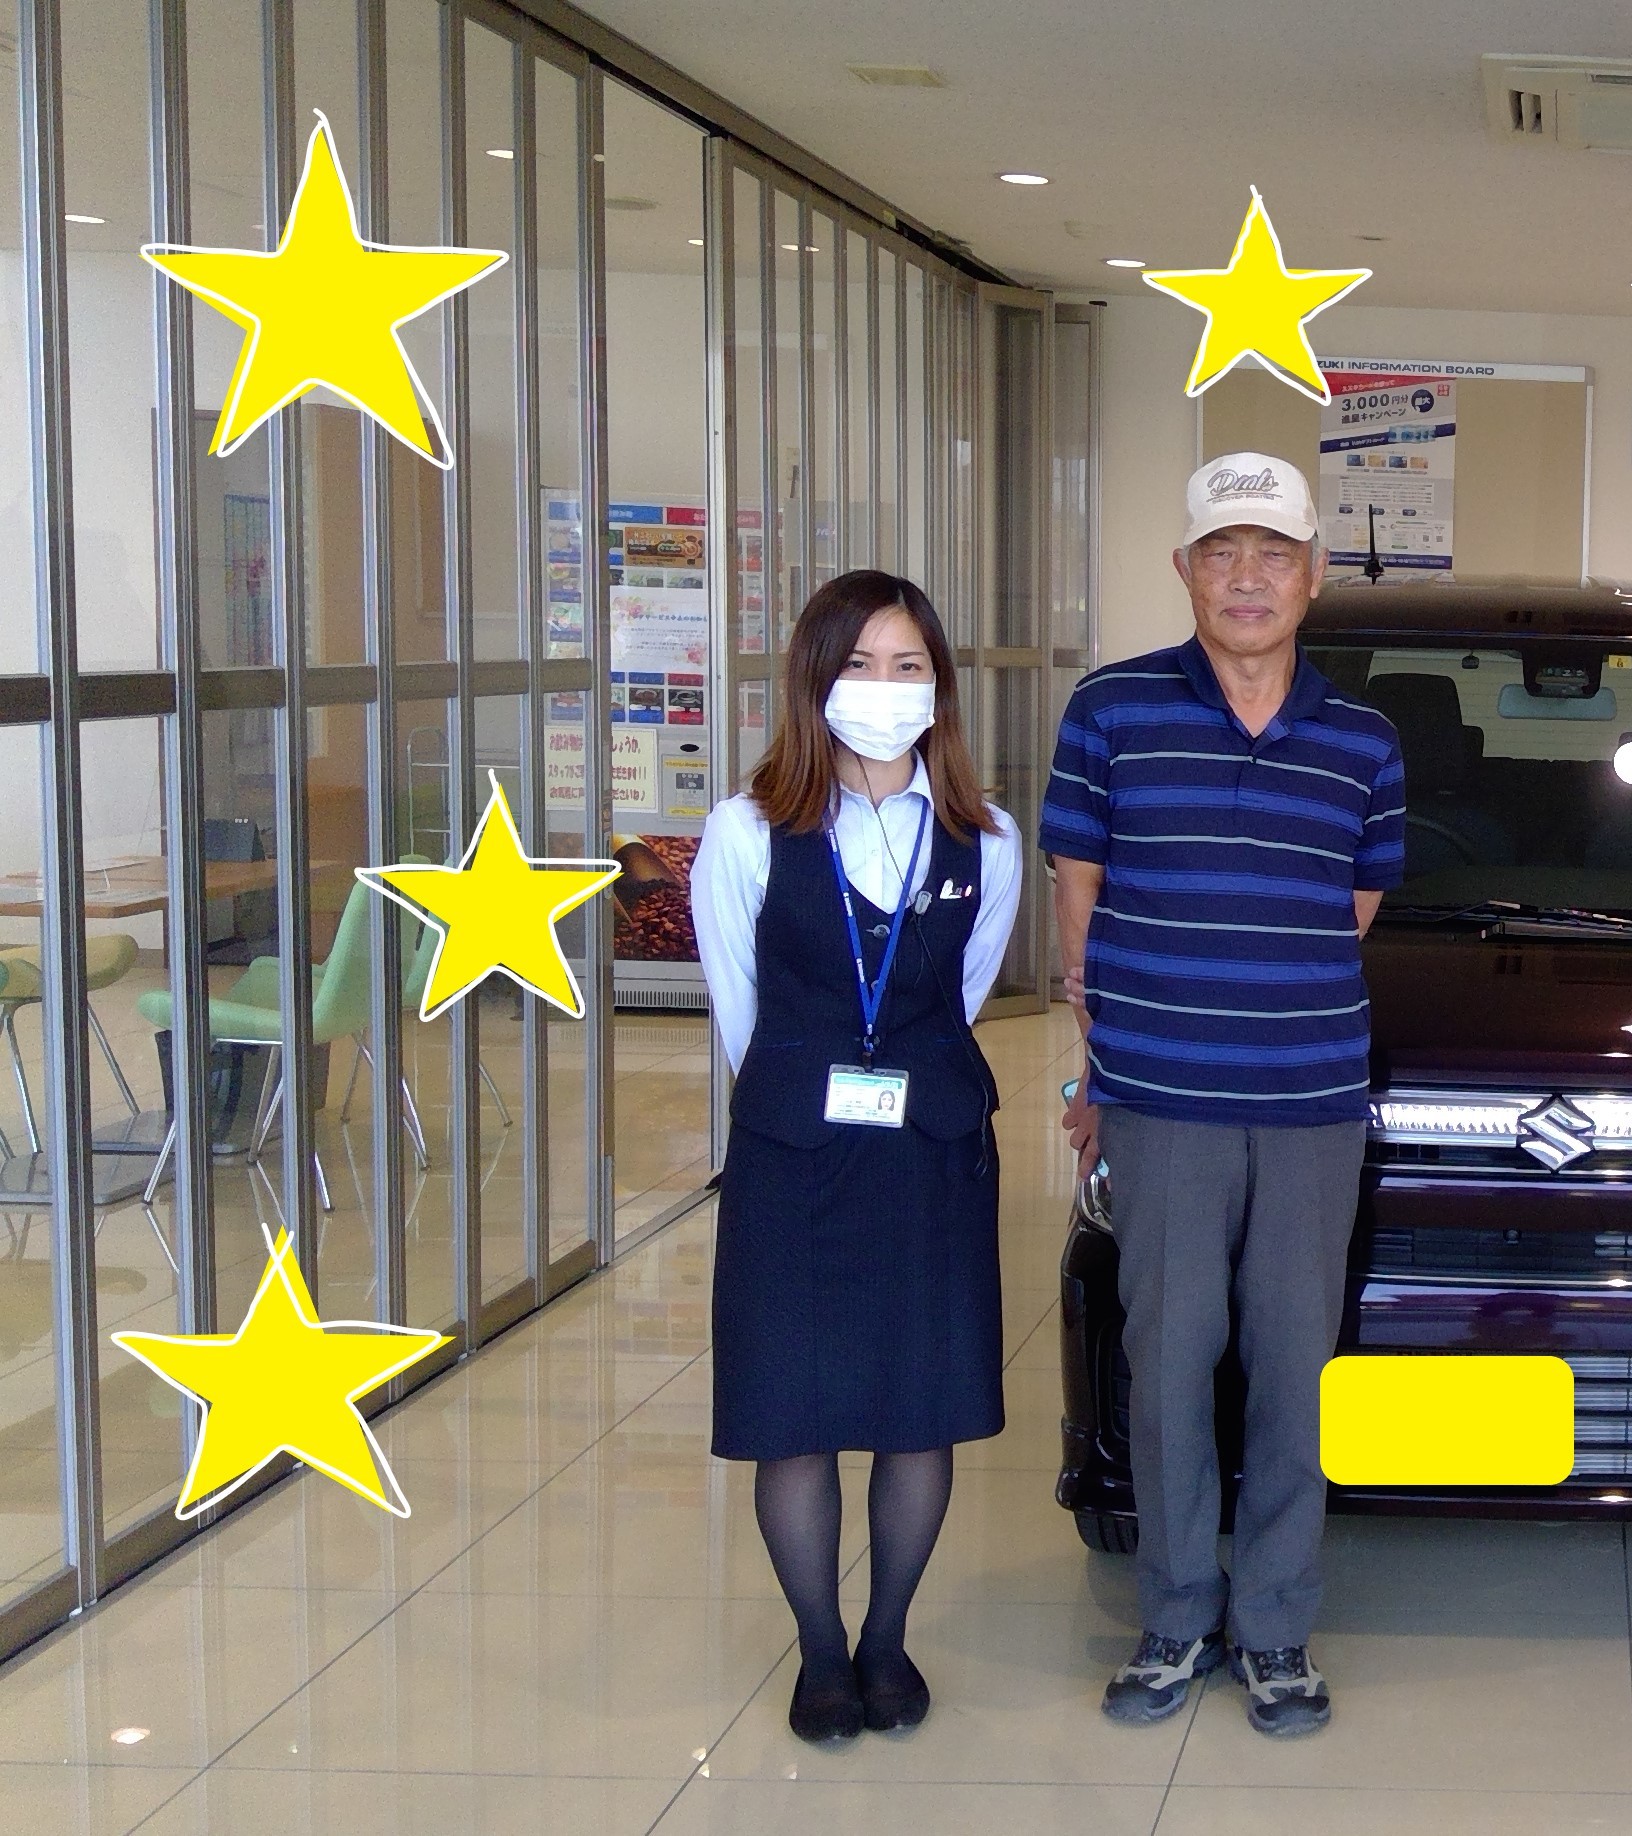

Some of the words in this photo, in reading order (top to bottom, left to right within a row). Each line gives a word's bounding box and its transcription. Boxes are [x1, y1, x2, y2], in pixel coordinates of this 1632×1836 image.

[1316, 360, 1344, 369] ZUKI
[1348, 361, 1442, 374] INFORMATION
[1445, 365, 1495, 376] BOARD
